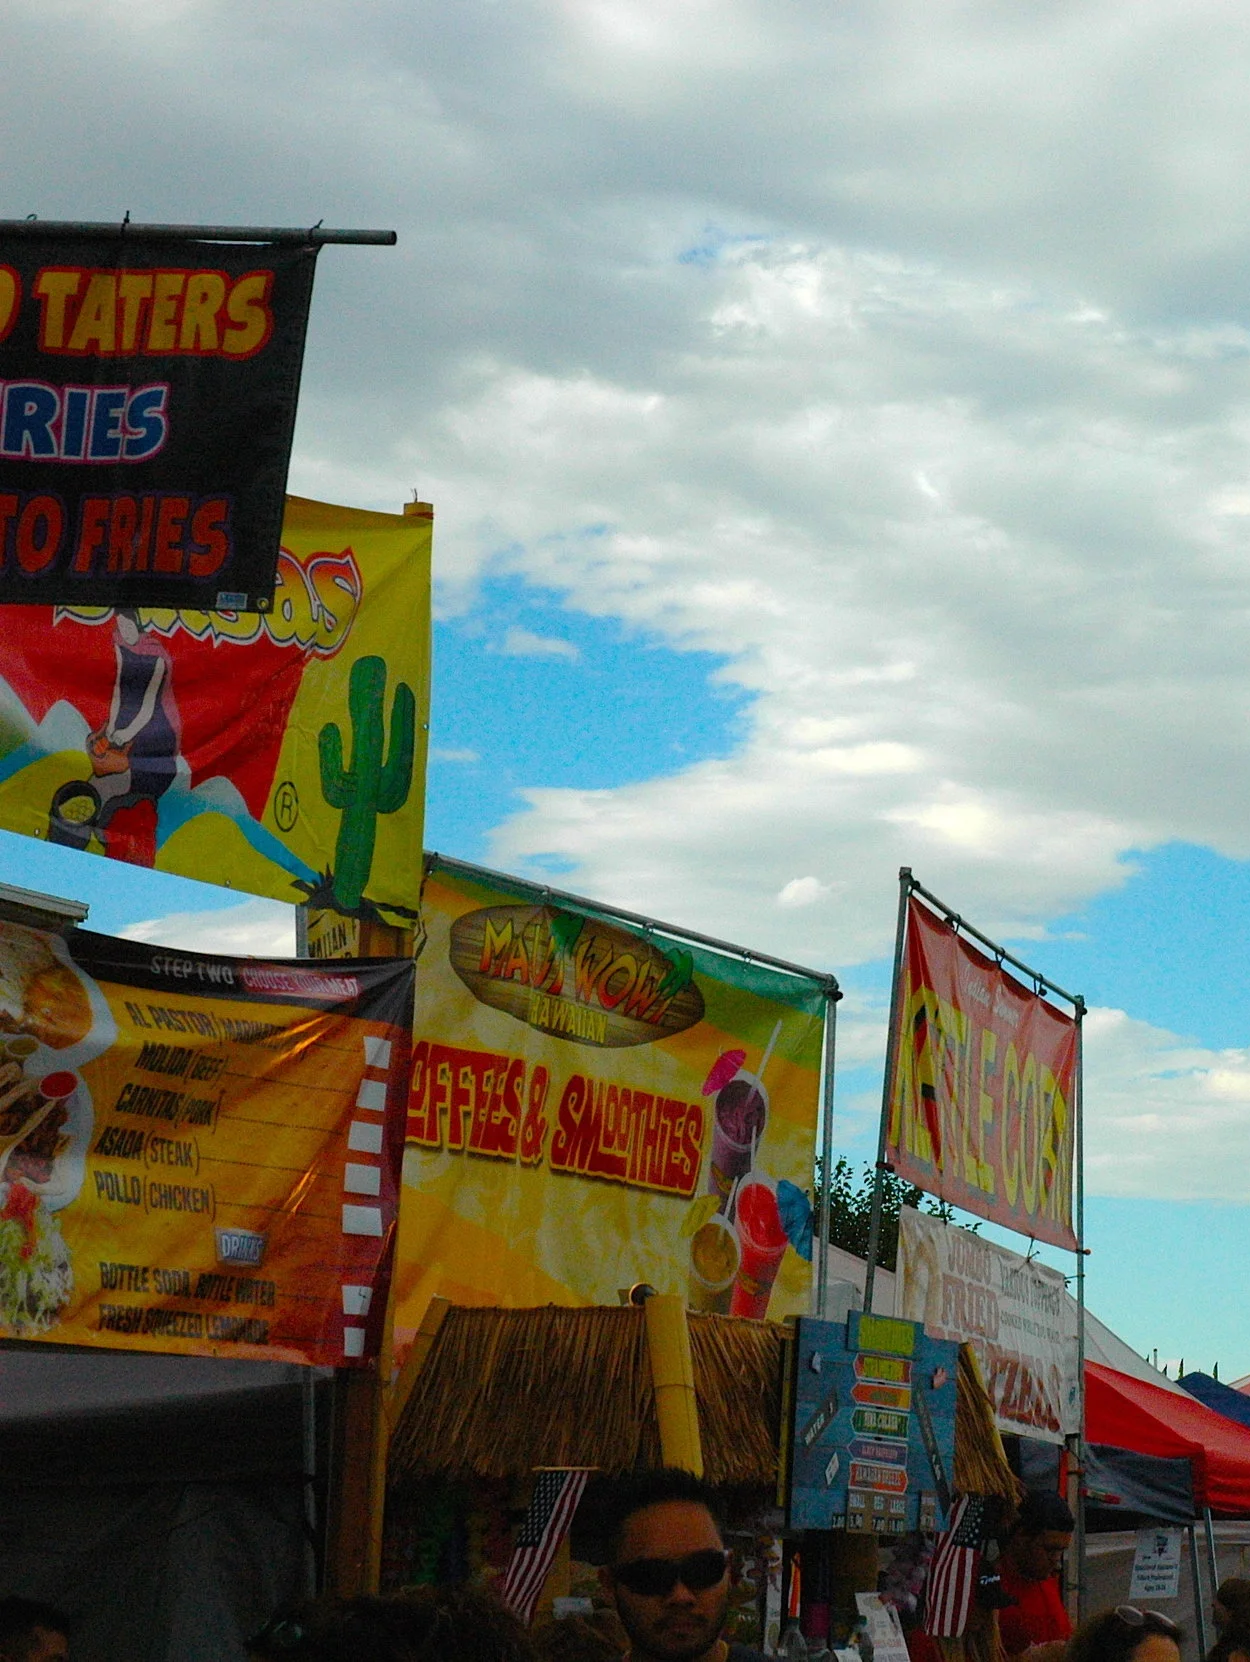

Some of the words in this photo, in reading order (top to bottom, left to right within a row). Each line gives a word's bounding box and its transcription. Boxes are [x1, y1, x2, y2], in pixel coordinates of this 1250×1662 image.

[33, 266, 274, 361] TATERS
[0, 380, 171, 465] RIES
[71, 494, 235, 581] FRIES
[150, 955, 193, 979] STEP
[198, 961, 234, 985] TWO
[242, 966, 293, 991] CHOOSE
[294, 973, 327, 993] YOUR
[326, 976, 360, 997] MEAT
[478, 917, 566, 995] MAUI
[574, 933, 676, 1025] WOWI
[149, 1004, 213, 1037] PASTOR
[528, 990, 608, 1043] HAWAIIAN
[115, 1083, 184, 1120] CARNITAS
[94, 1126, 144, 1160] ASADA
[144, 1130, 200, 1176] (STEAK)
[520, 1064, 551, 1165] &
[550, 1073, 706, 1197] SMOOTHIES
[93, 1170, 141, 1206] POLLO
[144, 1175, 216, 1218] (CHICKEN)
[221, 1233, 264, 1262] DRINKS
[99, 1261, 149, 1293] BOTTLE
[99, 1303, 142, 1333] FRESH
[941, 1273, 1000, 1340] FRIED
